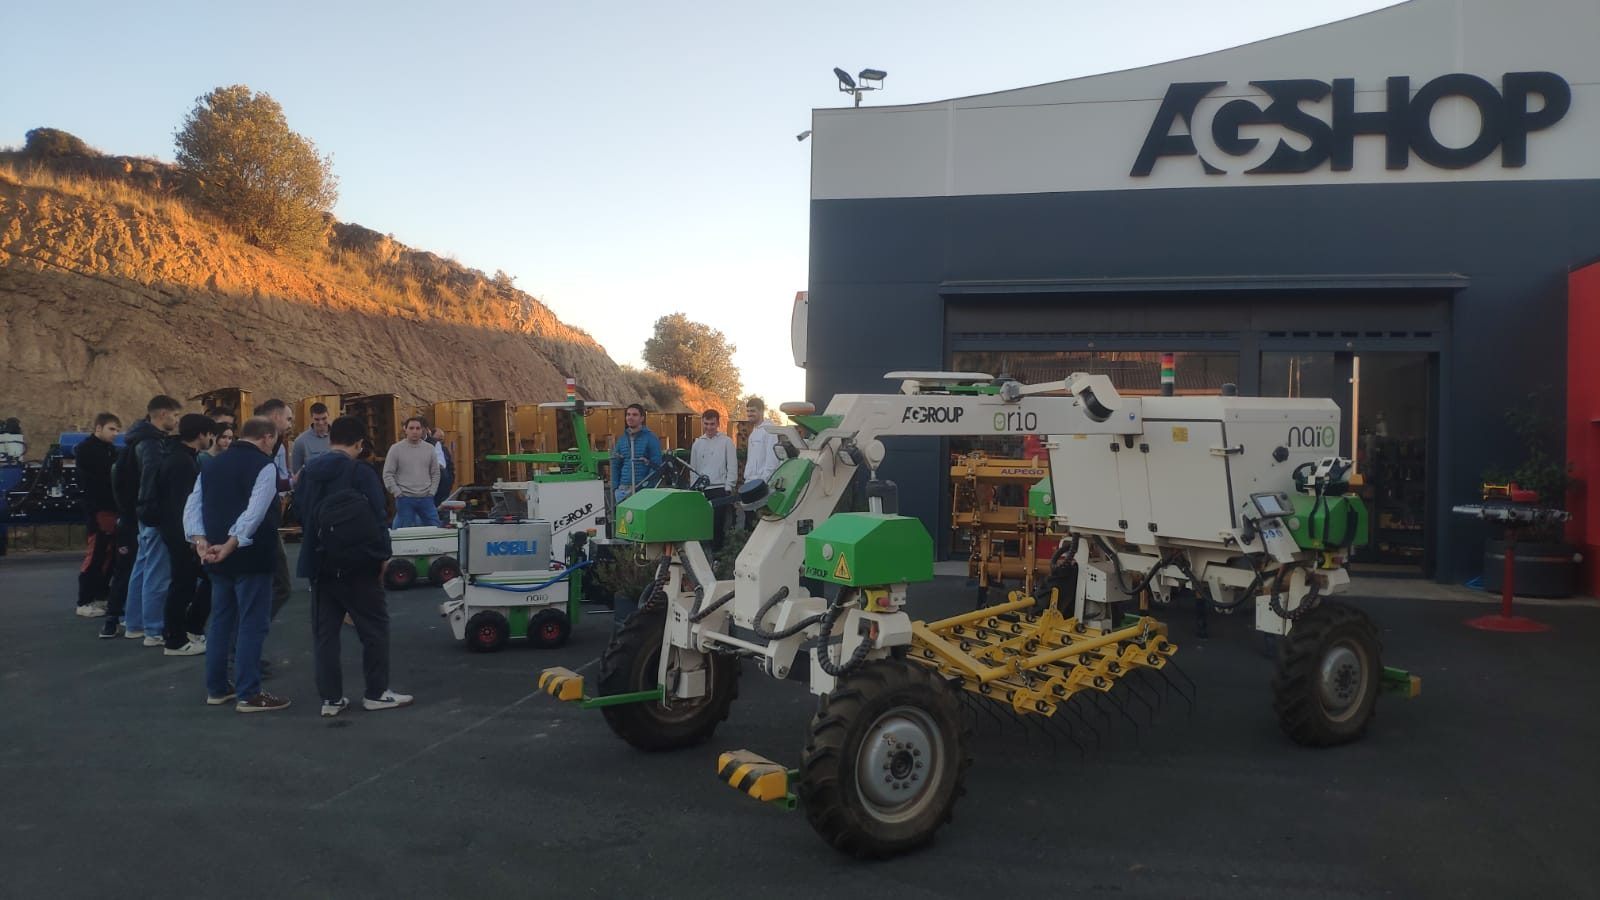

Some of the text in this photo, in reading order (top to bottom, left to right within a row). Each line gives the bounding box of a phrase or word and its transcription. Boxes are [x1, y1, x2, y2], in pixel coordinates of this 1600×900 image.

[1130, 71, 1572, 177] AGSHOP
[993, 406, 1037, 432] orio
[486, 540, 537, 557] NOBILI
